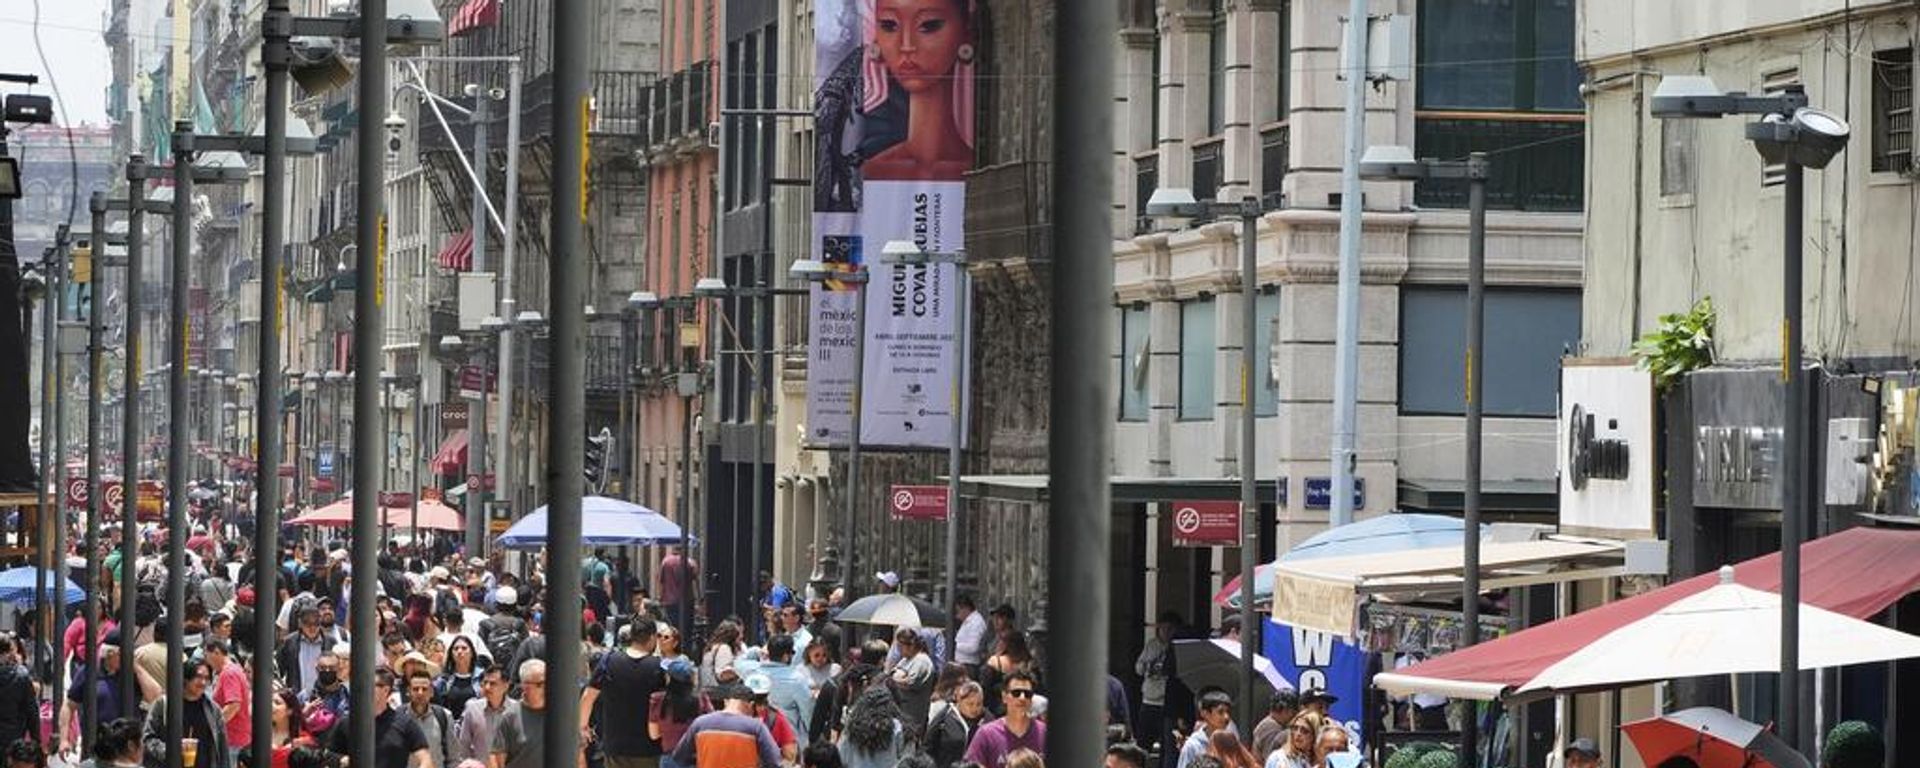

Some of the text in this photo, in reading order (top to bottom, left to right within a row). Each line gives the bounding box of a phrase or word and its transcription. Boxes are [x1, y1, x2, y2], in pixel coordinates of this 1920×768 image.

[913, 193, 927, 318] COVAUBIAS
[892, 263, 906, 317] MIGU
[819, 335, 857, 348] mexic
[442, 411, 467, 420] croc
